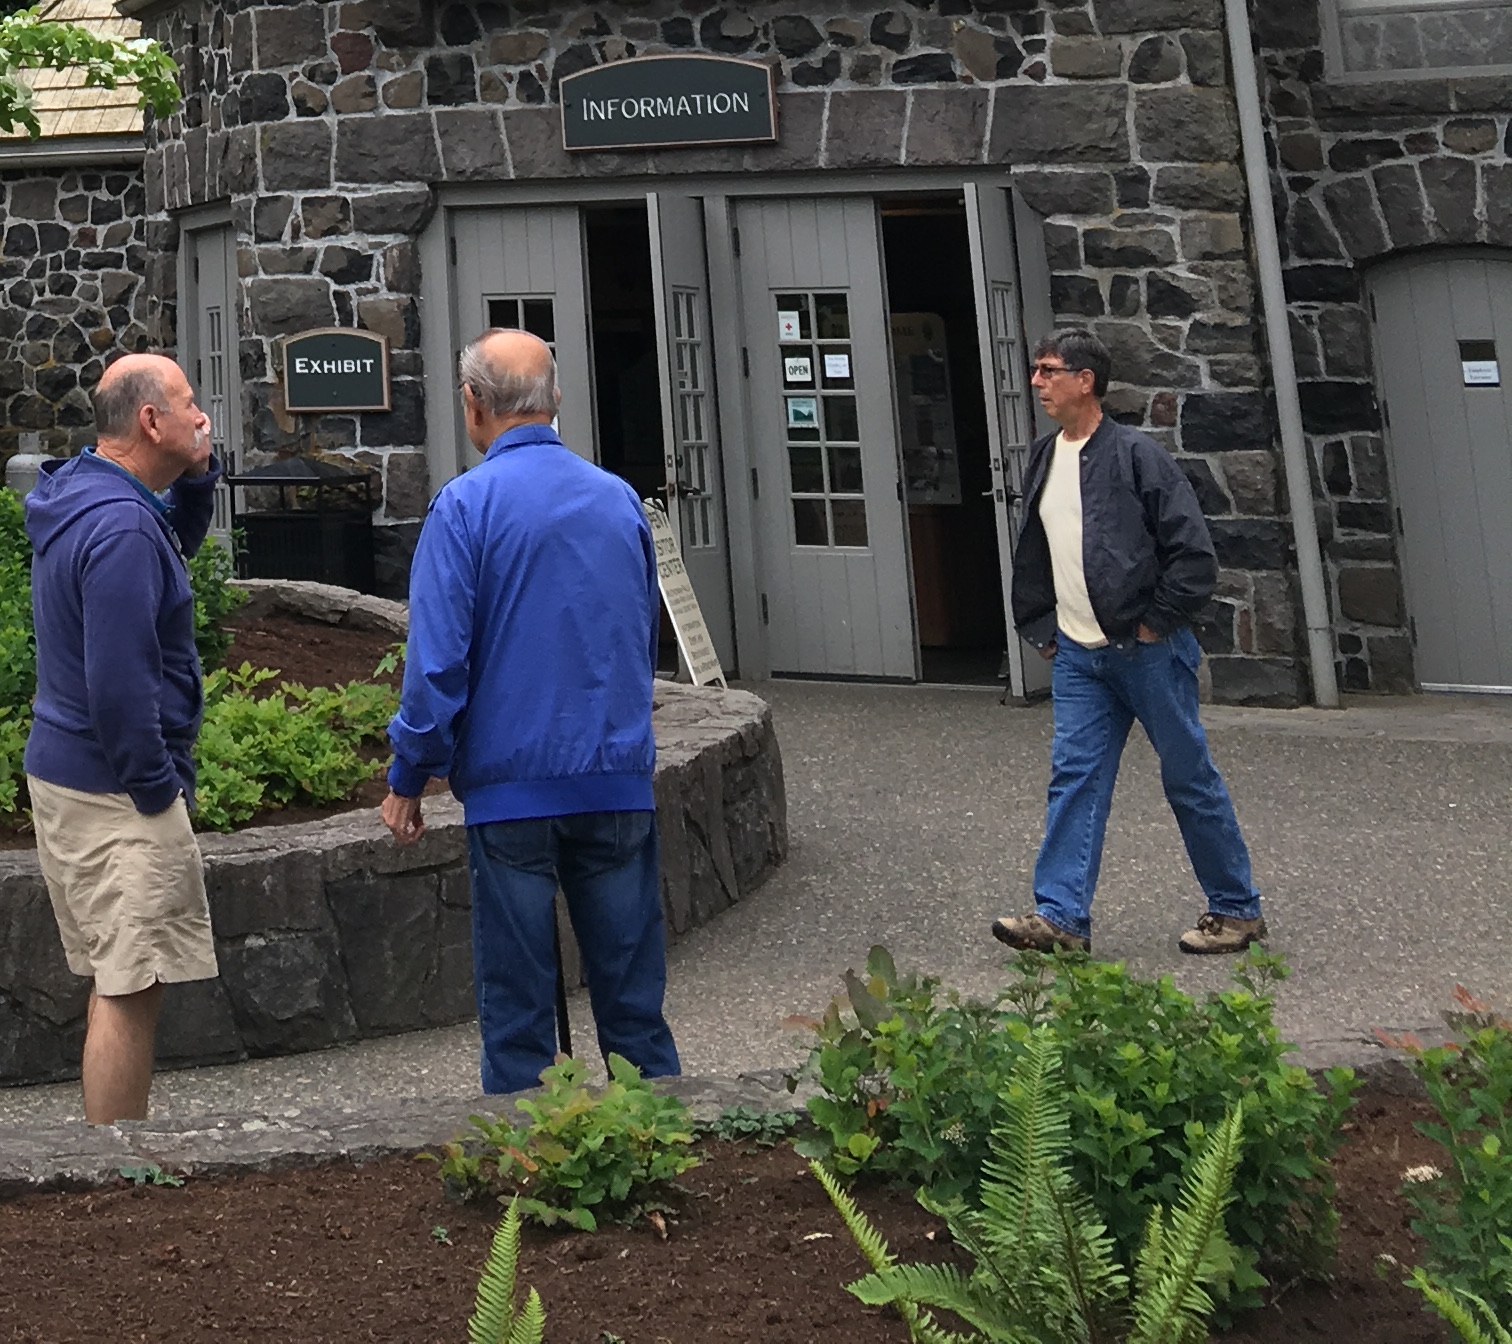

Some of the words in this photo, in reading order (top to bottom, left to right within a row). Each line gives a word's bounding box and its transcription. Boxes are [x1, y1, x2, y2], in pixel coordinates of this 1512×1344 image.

[582, 92, 750, 121] INFORMATION
[295, 357, 375, 374] EXHIBIT
[788, 365, 809, 376] OPEN
